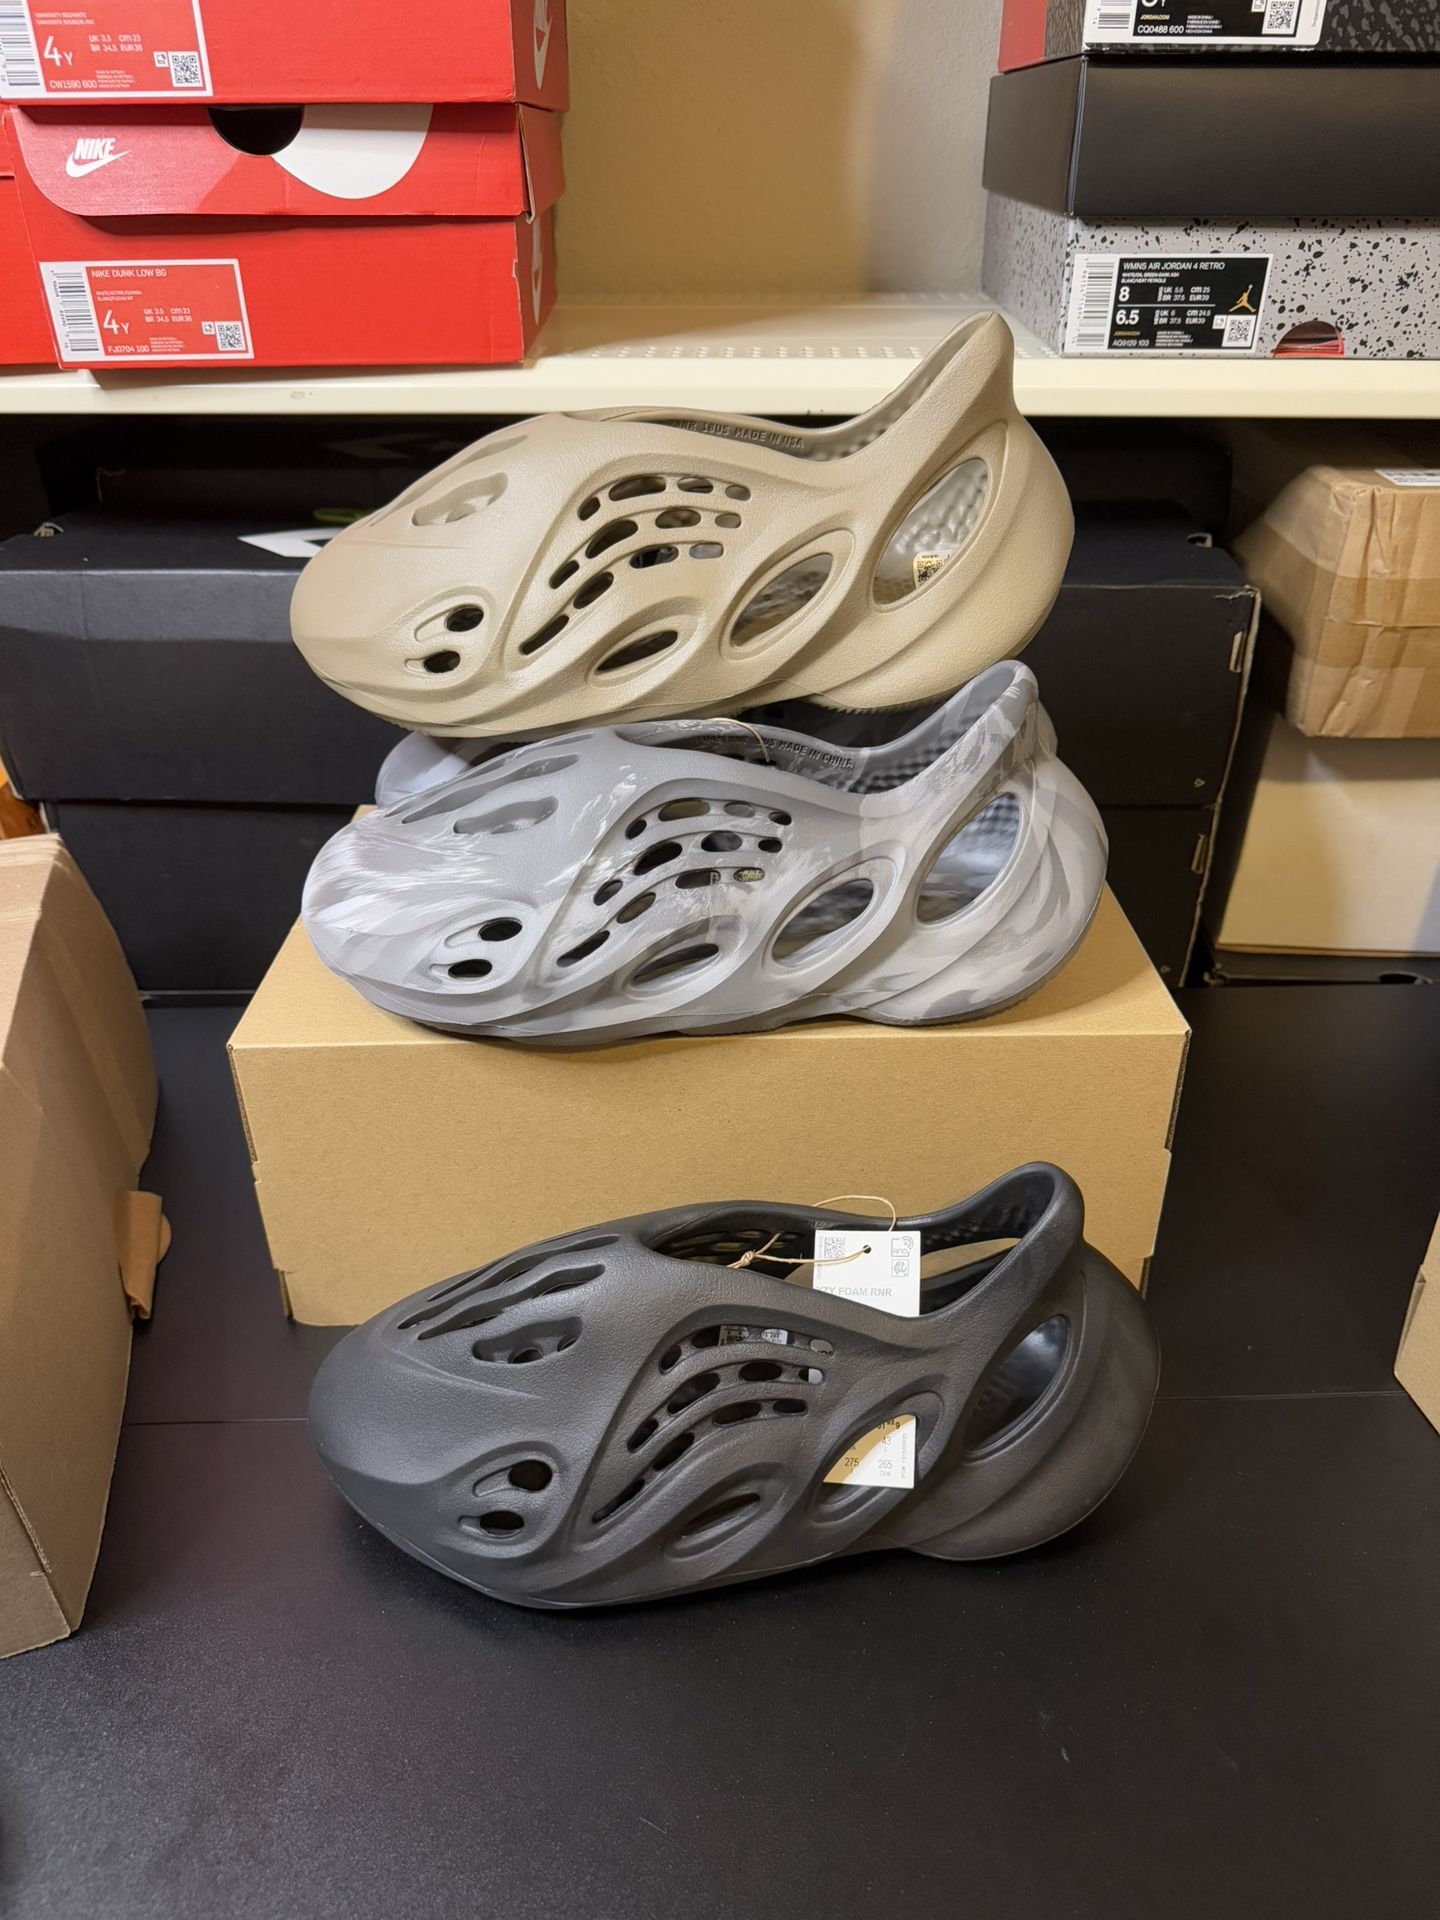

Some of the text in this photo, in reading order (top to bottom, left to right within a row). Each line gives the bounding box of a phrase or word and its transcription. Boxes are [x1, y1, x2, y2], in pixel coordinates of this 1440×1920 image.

[1137, 25, 1168, 34] CQ0488
[1169, 25, 1184, 34] 600
[89, 34, 99, 42] UK
[43, 35, 73, 66] 4 Y
[91, 44, 100, 52] BR
[49, 80, 97, 88] CW1590 600
[74, 137, 116, 160] NIKE
[1123, 262, 1225, 270] WMNS AIR JORDAN 4 RETRO
[91, 269, 111, 278] NIKE
[111, 269, 135, 278] DUNK
[135, 268, 154, 277] LOW
[1118, 286, 1130, 302] 8
[103, 310, 129, 334] 4 Y
[1115, 309, 1139, 325] 6.5
[1158, 317, 1167, 325] BR
[1169, 317, 1182, 325] 37.5
[1138, 339, 1149, 347] 103
[108, 345, 135, 353] FJ0704
[734, 426, 766, 442] MADE
[769, 431, 782, 445] IN
[783, 435, 805, 449] USA
[778, 740, 808, 755] MADE
[808, 748, 822, 760] IN
[822, 752, 854, 768] CHINA
[838, 1287, 867, 1297] FOAM
[870, 1287, 893, 1297] RNR
[844, 1457, 893, 1469] 275 265
